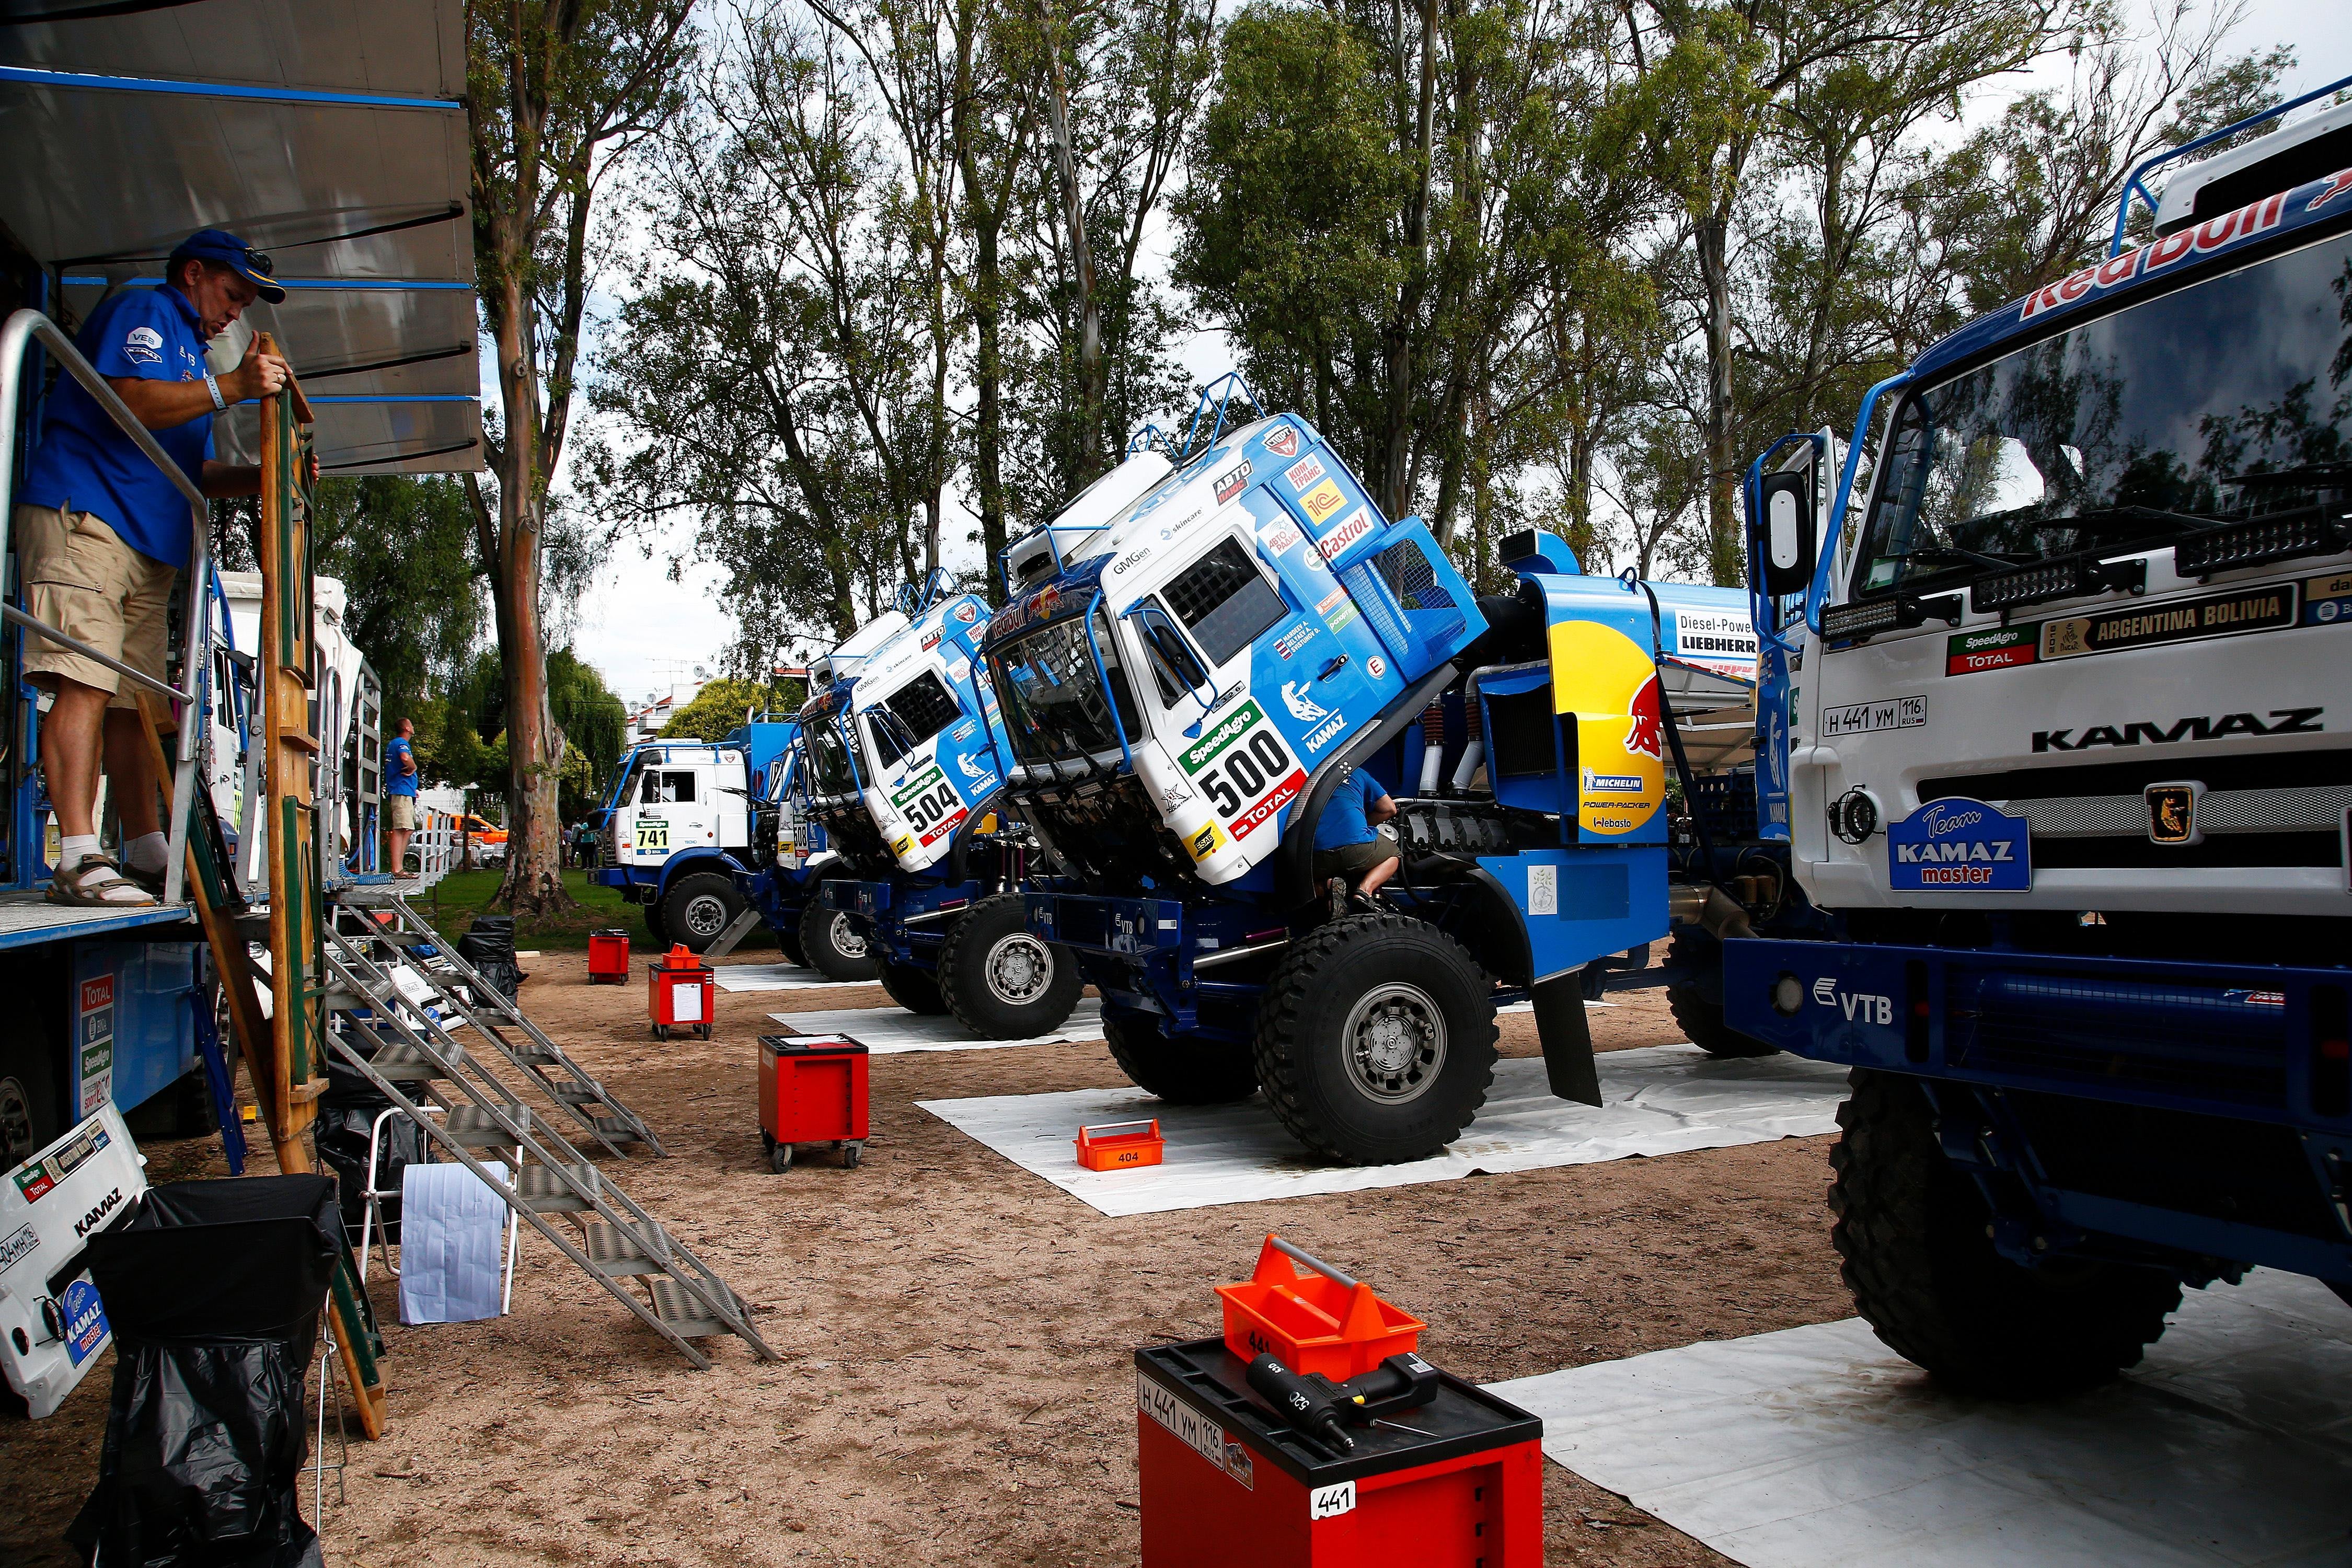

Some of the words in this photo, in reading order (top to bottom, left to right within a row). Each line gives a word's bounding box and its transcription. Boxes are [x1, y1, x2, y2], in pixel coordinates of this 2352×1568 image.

[133, 333, 155, 345] VEB
[1266, 428, 1290, 446] СПОРТ
[1217, 463, 1250, 494] АВТО
[1288, 462, 1309, 481] КОМ
[1294, 465, 1320, 489] ТРАНС
[1218, 479, 1245, 502] ПЛЮС
[1172, 509, 1202, 533] skincare
[1269, 531, 1287, 550] АВТО
[1276, 531, 1300, 552] РАДИО
[1320, 512, 1369, 559] Castrol
[1113, 547, 1150, 574] GMGen
[1321, 587, 1345, 608] ЧЕМПИОНАТ
[1329, 609, 1349, 630] р-спорт
[2096, 610, 2196, 642] ARGENTINA
[2203, 596, 2281, 626] BOLIVIA
[922, 626, 944, 645] АВТО
[969, 625, 982, 637] КОМ
[1283, 624, 1304, 642] MARDEEV
[1286, 629, 1307, 648] BELYAEV
[1966, 631, 2018, 649] SpeedAgro
[923, 637, 940, 651] ПЛЮС
[1290, 631, 1316, 653] SVISTUNOV
[1682, 636, 1757, 653] LIEBHERR
[893, 654, 912, 668] skincare
[1370, 659, 1383, 674] E
[1966, 653, 2013, 667] TOTAL
[953, 667, 965, 678] АВТО
[856, 675, 880, 692] GMGen
[1829, 714, 1839, 732] Н
[1843, 706, 1869, 730] 441
[1876, 708, 1894, 727] УМ
[1902, 699, 1921, 716] 116
[1189, 711, 1251, 764] SpeedAgro
[1305, 713, 1348, 754] KAMAZ
[2032, 707, 2324, 753] KAMAZ
[1197, 730, 1289, 818] 500
[1596, 779, 1640, 788] MICHELIN
[897, 771, 937, 801] SpeedAgro
[970, 774, 998, 797] KAMAZ
[903, 782, 959, 833] 504
[1244, 788, 1294, 824] TOTAL
[929, 817, 961, 838] TOTAL
[1593, 817, 1631, 827] Webasto
[1922, 805, 1981, 838] Team
[638, 830, 667, 846] 741
[794, 826, 807, 847] 508
[1195, 834, 1214, 850] ESAB
[1898, 841, 2013, 862] KAMAZ
[1921, 864, 1992, 883] master
[1043, 913, 1052, 925] VTB
[1121, 920, 1133, 934] VTB
[85, 986, 111, 1006] TOTAL
[1840, 993, 1893, 1024] VTB
[85, 1048, 110, 1073] SpeedAgro
[1118, 1152, 1138, 1162] 404
[30, 1182, 48, 1195] TOTAL
[74, 1187, 123, 1239] KAMAZ
[23, 1227, 34, 1241] 116
[67, 1287, 86, 1317] Team
[67, 1301, 102, 1344] KAMAZ
[79, 1321, 102, 1352] master
[1249, 1331, 1270, 1353] 441
[1289, 1391, 1310, 1410] 520
[1154, 1389, 1176, 1429] 441
[1181, 1412, 1197, 1445] УМ
[1203, 1421, 1219, 1448] 116
[1204, 1444, 1215, 1459] RUS
[1230, 1462, 1248, 1478] KAMAZ
[1317, 1488, 1352, 1512] 441
